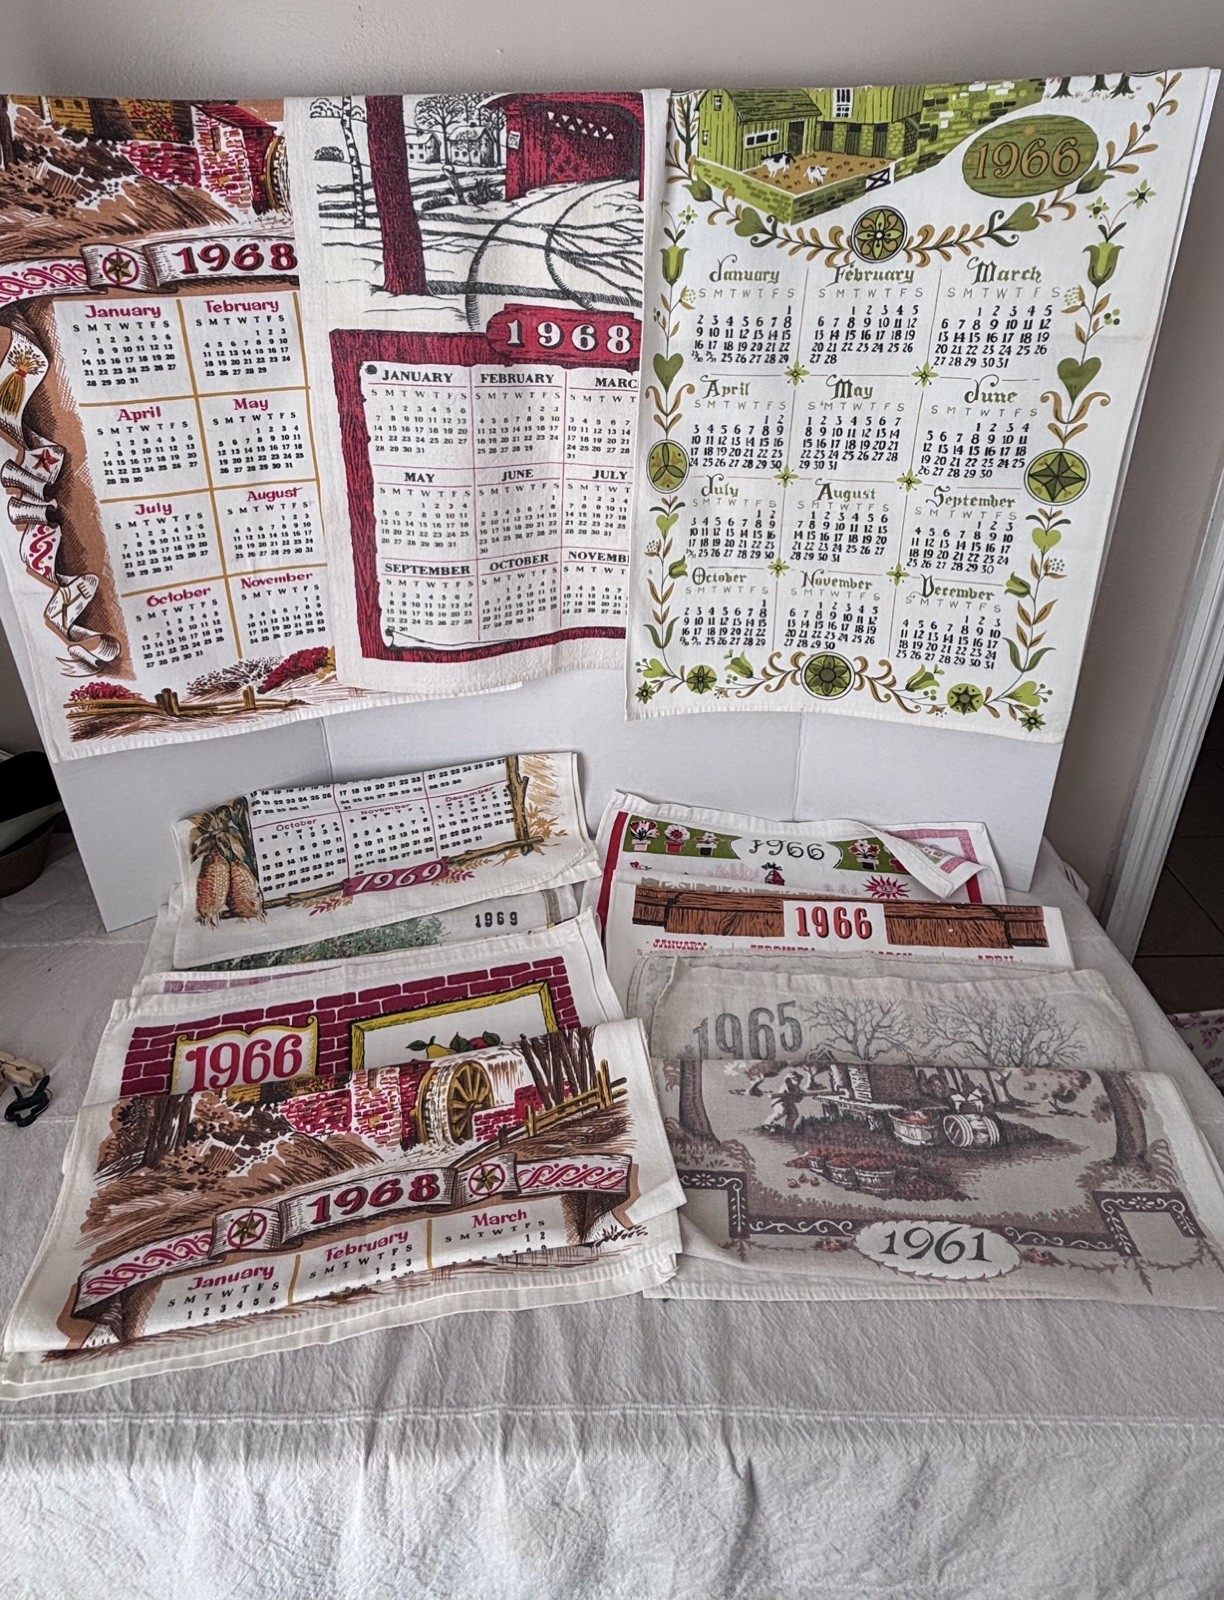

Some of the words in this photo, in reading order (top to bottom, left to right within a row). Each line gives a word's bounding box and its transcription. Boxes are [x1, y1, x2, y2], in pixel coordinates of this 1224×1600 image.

[973, 137, 1080, 179] 1966
[174, 242, 298, 274] 1968
[709, 254, 780, 284] January
[826, 260, 915, 287] February
[967, 256, 1042, 285] March
[85, 305, 161, 319] January
[205, 300, 279, 314] February
[787, 306, 791, 314] 1
[698, 315, 704, 324] 2
[712, 315, 719, 325] 3
[726, 316, 733, 326] 4
[742, 316, 749, 326] 5
[756, 317, 764, 327] 6
[771, 317, 777, 327] 7
[783, 316, 792, 328] 8
[506, 319, 632, 355] 1968
[696, 327, 703, 336] 9
[709, 328, 720, 338] 10
[725, 329, 733, 338] 11
[739, 329, 750, 339] 12
[753, 330, 764, 340] 13
[768, 330, 778, 340] 14
[782, 330, 791, 340] 15
[694, 340, 704, 349] 16
[709, 340, 717, 349] 17
[724, 341, 733, 350] 18
[738, 342, 747, 351] 19
[750, 342, 763, 351] 20
[765, 342, 776, 351] 21
[779, 342, 790, 352] 22
[721, 353, 733, 362] 25
[735, 354, 747, 363] 26
[750, 354, 762, 363] 27
[764, 354, 775, 364] 28
[778, 354, 788, 363] 29
[382, 370, 454, 384] JANUARY
[480, 373, 555, 385] FEBRUARY
[700, 375, 751, 399] April
[826, 374, 873, 400] May
[964, 374, 1018, 404] June
[117, 406, 162, 423] April
[233, 398, 269, 411] May
[404, 472, 435, 483] MAY
[501, 469, 534, 481] JUNE
[592, 469, 628, 480] JULY
[247, 487, 303, 502] August
[701, 474, 739, 497] July
[815, 478, 877, 501] August
[926, 486, 1016, 508] September
[135, 502, 173, 516] July
[384, 563, 471, 576] SEPTEMBER
[489, 553, 549, 572] OCTOBER
[240, 573, 313, 589] November
[692, 567, 748, 585] October
[801, 569, 874, 590] November
[146, 587, 211, 607] October
[910, 574, 995, 600] December
[903, 619, 909, 628] 4
[918, 620, 924, 628] 5
[931, 621, 937, 630] 6
[947, 624, 953, 632] 7
[961, 625, 969, 635] 8
[976, 627, 983, 636] 9
[990, 628, 1001, 638] 10
[964, 616, 969, 624] 1
[978, 617, 985, 625] 2
[994, 618, 1001, 627] 3
[900, 629, 908, 638] 11
[913, 630, 923, 639] 12
[928, 632, 939, 641] 13
[943, 634, 954, 643] 14
[958, 636, 969, 645] 15
[973, 638, 983, 647] 16
[987, 639, 998, 649] 17
[896, 650, 907, 659] 25
[910, 651, 921, 660] 26
[925, 652, 936, 662] 27
[939, 654, 951, 664] 28
[953, 656, 965, 665] 29
[969, 658, 981, 667] 30
[984, 660, 994, 670] 31
[899, 640, 908, 649] 18
[912, 641, 923, 650] 19
[927, 642, 938, 651] 20
[941, 644, 951, 653] 21
[955, 646, 967, 655] 22
[970, 648, 982, 657] 23
[985, 650, 997, 660] 24
[361, 803, 411, 815] November
[276, 819, 317, 831] October
[749, 840, 825, 860] 1966
[355, 863, 442, 891] 1969
[475, 911, 518, 928] 1969
[795, 906, 872, 939] 1966
[693, 1001, 802, 1060] 1965
[185, 1033, 302, 1093] 1966
[307, 1173, 441, 1224] 1968
[472, 1209, 527, 1229] March
[325, 1230, 408, 1262] February
[880, 1226, 992, 1264] 1961
[187, 1265, 275, 1291] January
